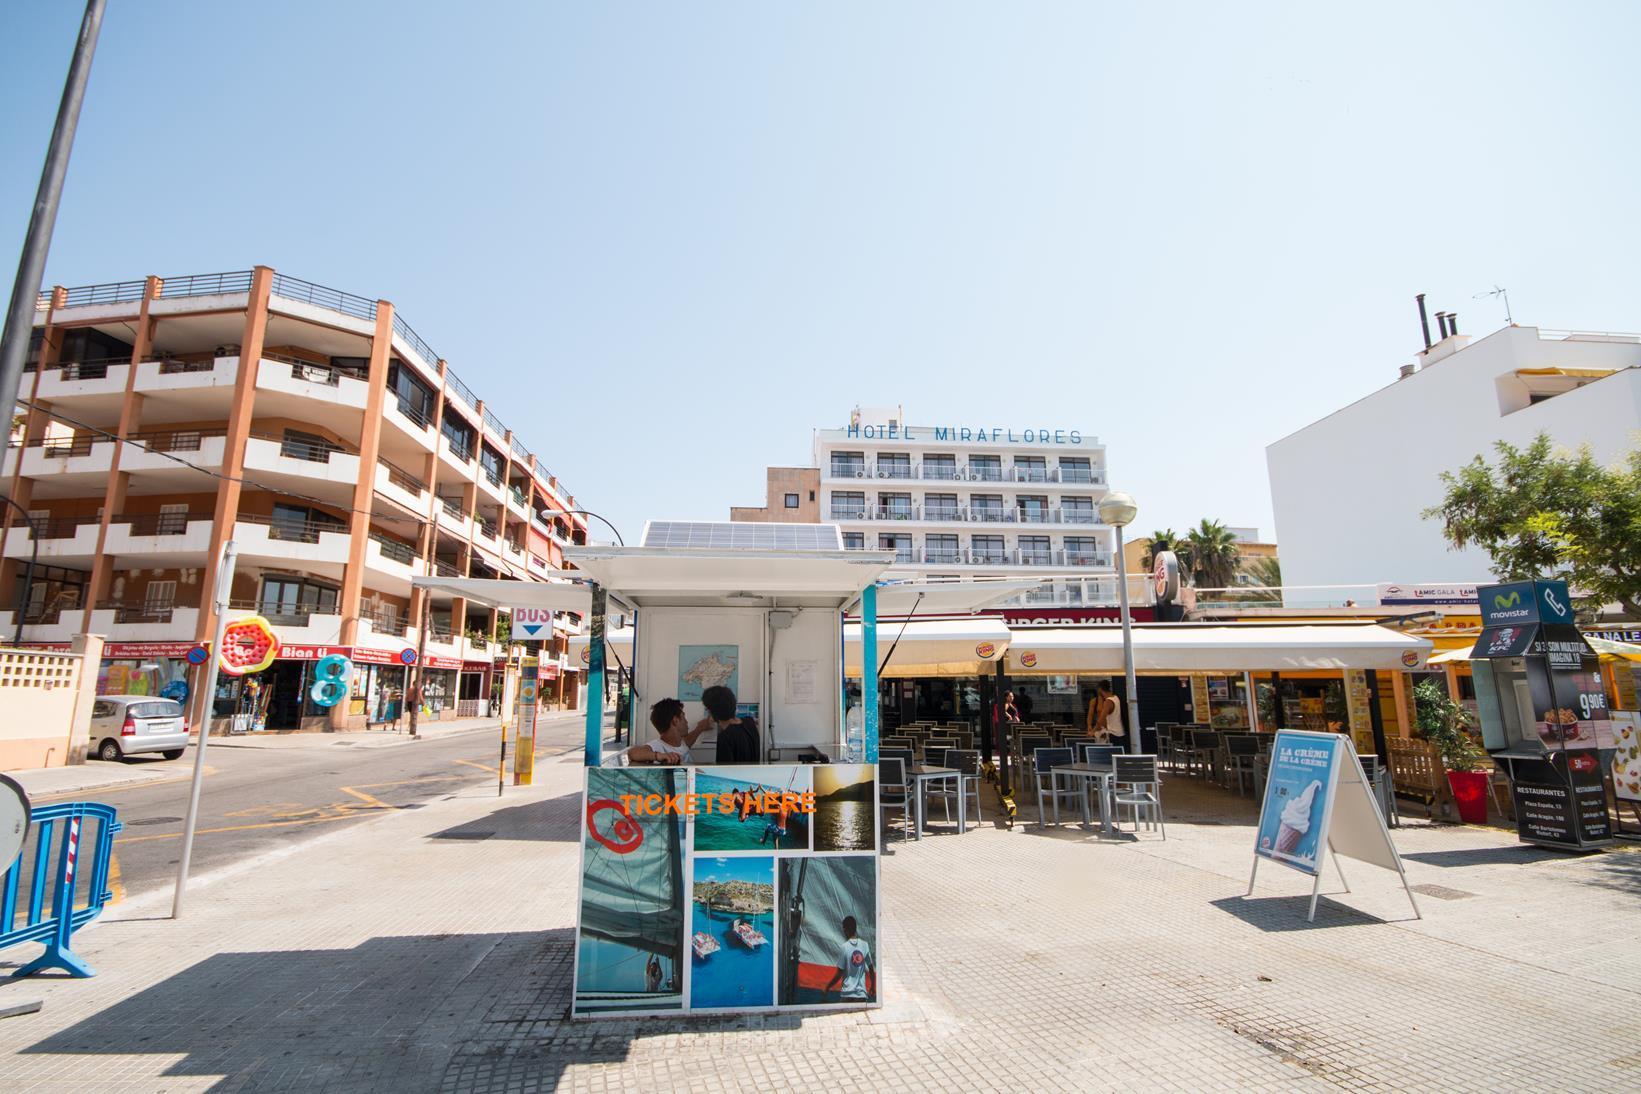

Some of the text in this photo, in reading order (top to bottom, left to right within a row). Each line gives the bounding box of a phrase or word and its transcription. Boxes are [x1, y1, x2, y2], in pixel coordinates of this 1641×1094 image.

[847, 424, 1083, 445] HOTEL MIRAFLORES
[1490, 608, 1529, 620] movistar
[1548, 641, 1560, 652] SON
[281, 647, 328, 659] Bian Li
[1280, 747, 1292, 756] LA
[1516, 786, 1566, 797] RESTAURANTES
[618, 792, 817, 816] TICKETS HERE
